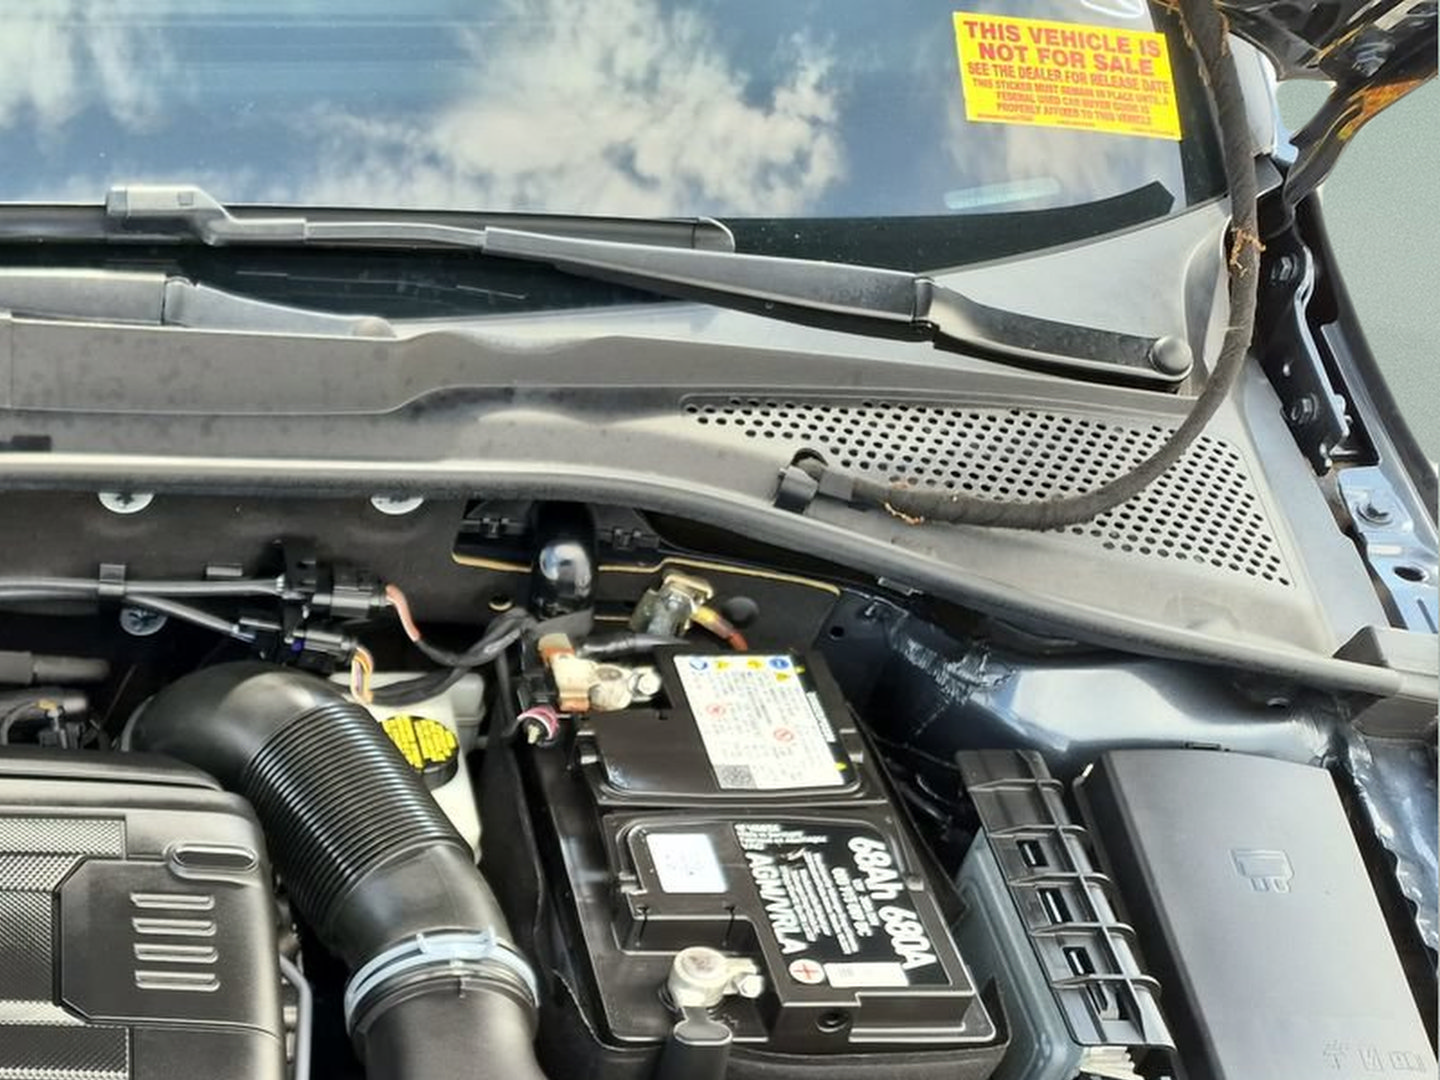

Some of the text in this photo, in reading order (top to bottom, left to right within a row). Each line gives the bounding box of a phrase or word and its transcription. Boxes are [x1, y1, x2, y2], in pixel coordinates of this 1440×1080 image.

[963, 20, 1162, 58] THIS VEHICLE IS
[968, 61, 1171, 94] SEE THE DEALER FOR RELEASE DATE
[978, 42, 1154, 76] NOT FOR SALE
[744, 851, 809, 954] AGM/VRLA
[848, 835, 937, 970] 68Ah 680A
